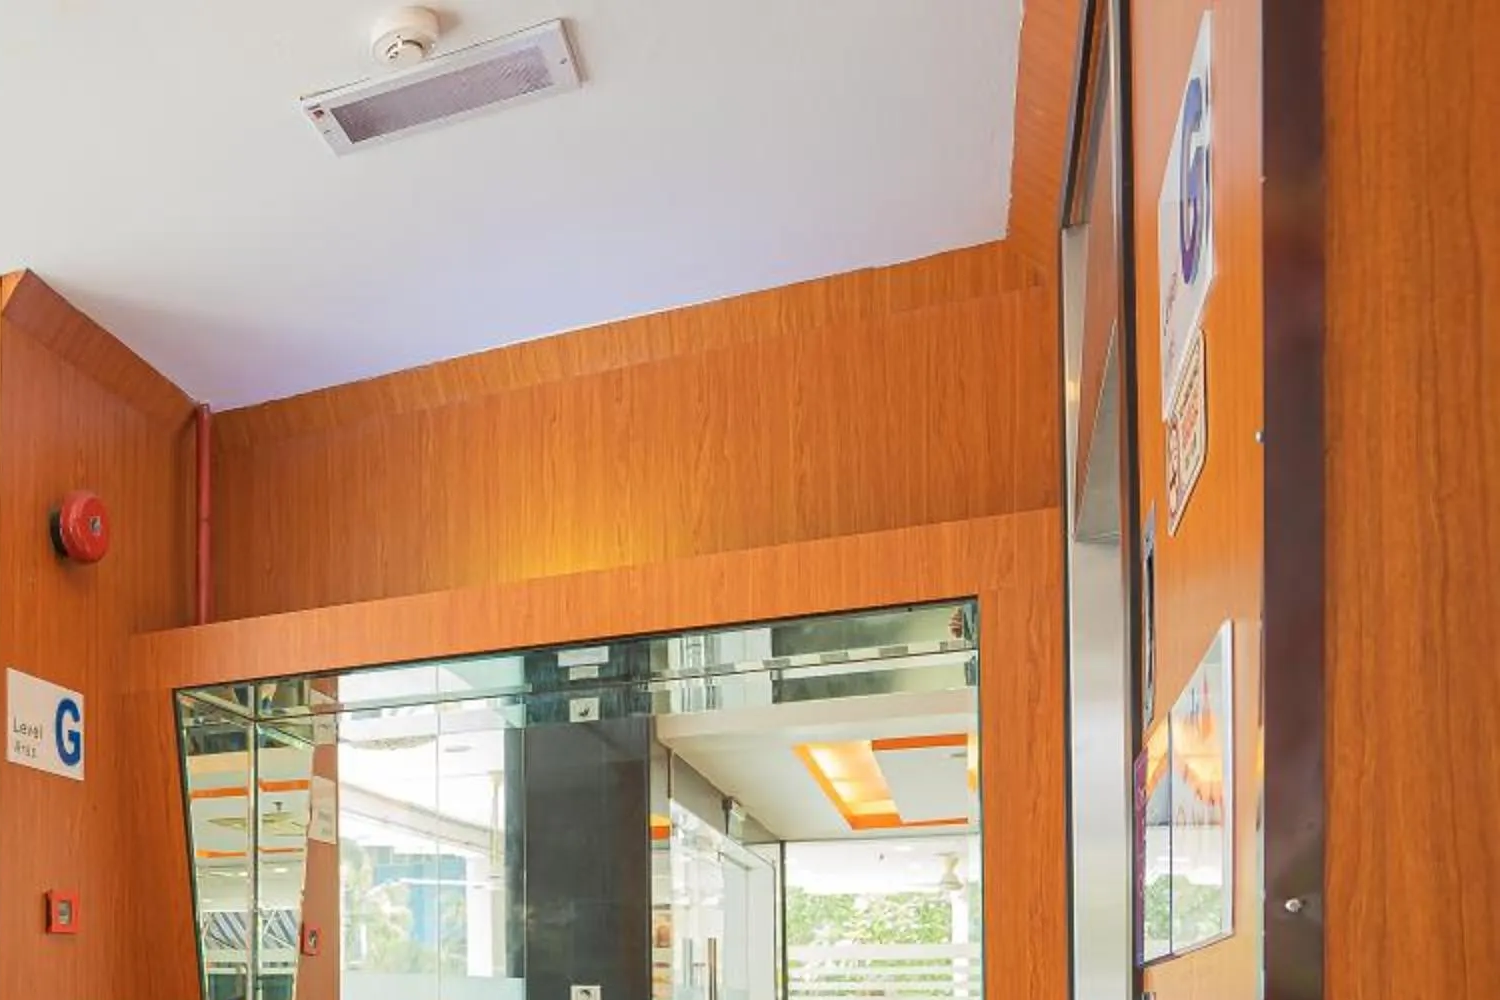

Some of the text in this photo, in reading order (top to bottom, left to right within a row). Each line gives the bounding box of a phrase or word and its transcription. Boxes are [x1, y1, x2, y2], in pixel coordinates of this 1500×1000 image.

[1180, 77, 1204, 284] G
[13, 717, 43, 740] Level
[56, 698, 80, 766] G
